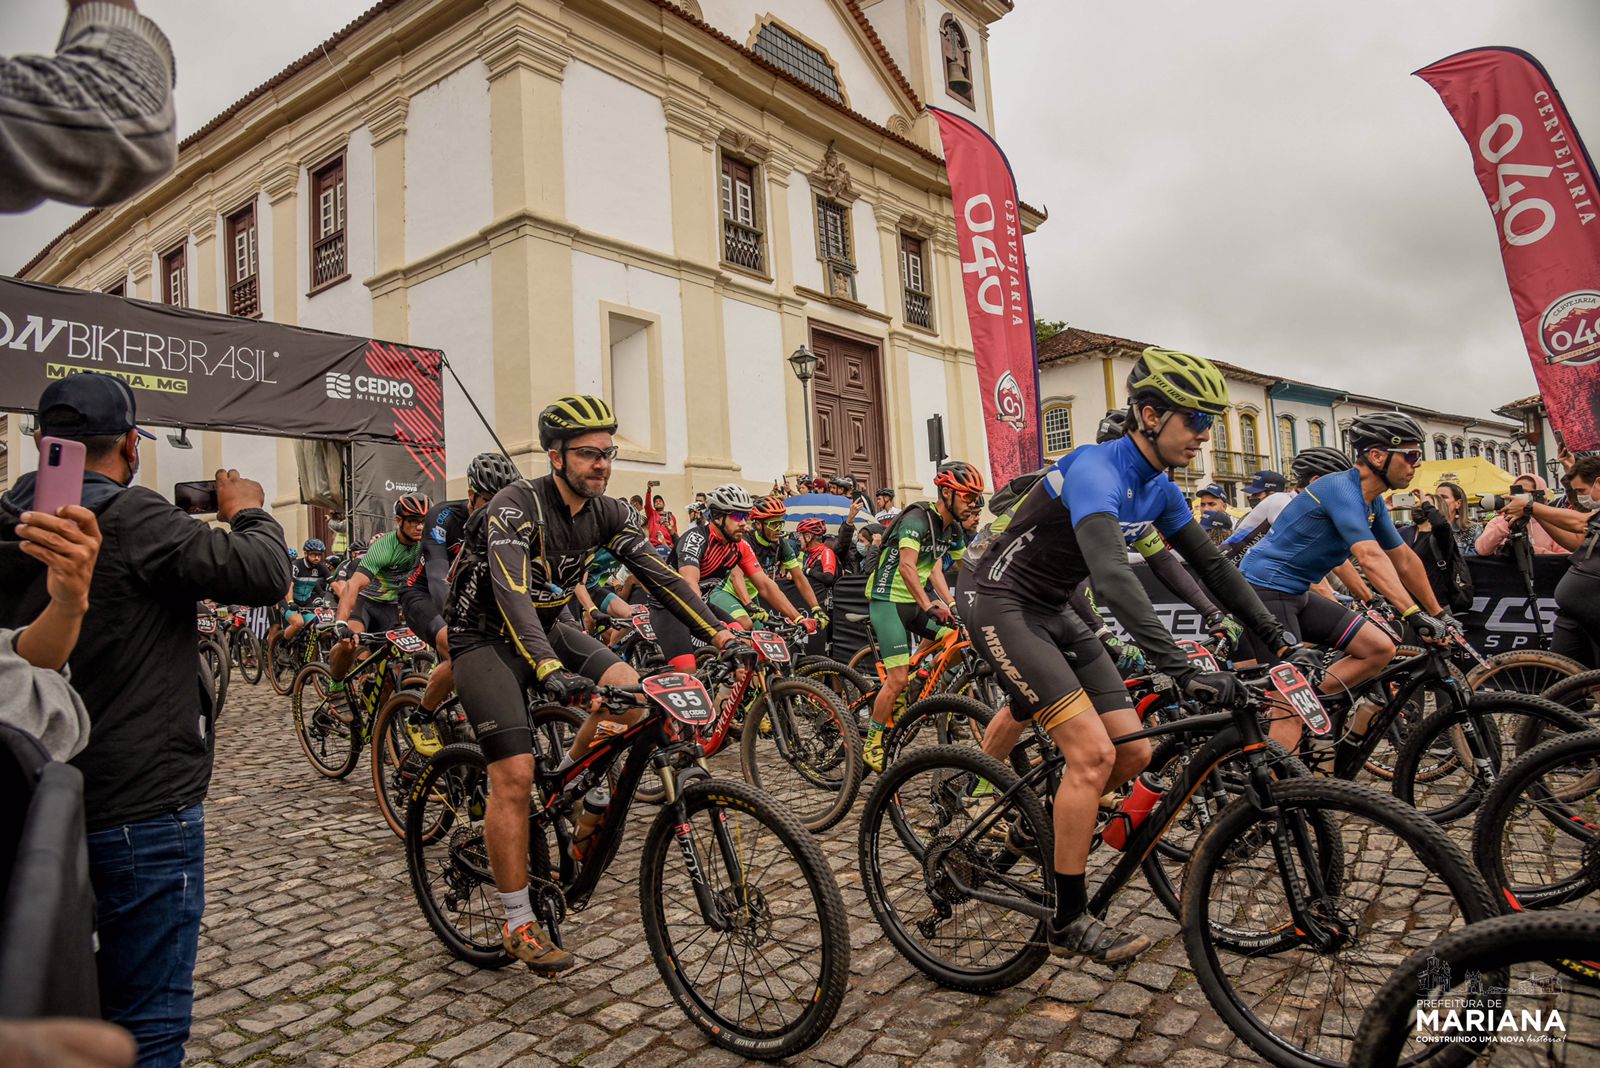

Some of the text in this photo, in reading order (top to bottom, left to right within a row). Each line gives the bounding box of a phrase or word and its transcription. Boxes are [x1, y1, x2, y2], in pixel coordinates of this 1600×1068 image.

[1533, 89, 1597, 226] CERVEJARIA
[1479, 112, 1556, 247] 040
[962, 193, 1005, 316] 040
[1003, 199, 1025, 327] CERVEJARIA
[1553, 297, 1597, 318] CERVEJARIA
[156, 378, 188, 393] MG
[355, 375, 414, 399] CEDRO
[356, 393, 414, 408] MINERAÇÃO
[395, 635, 420, 647] 1032
[762, 643, 783, 654] 91
[981, 624, 1040, 705] MTBWEAR
[667, 690, 702, 708] 85
[1290, 688, 1321, 716] 1343
